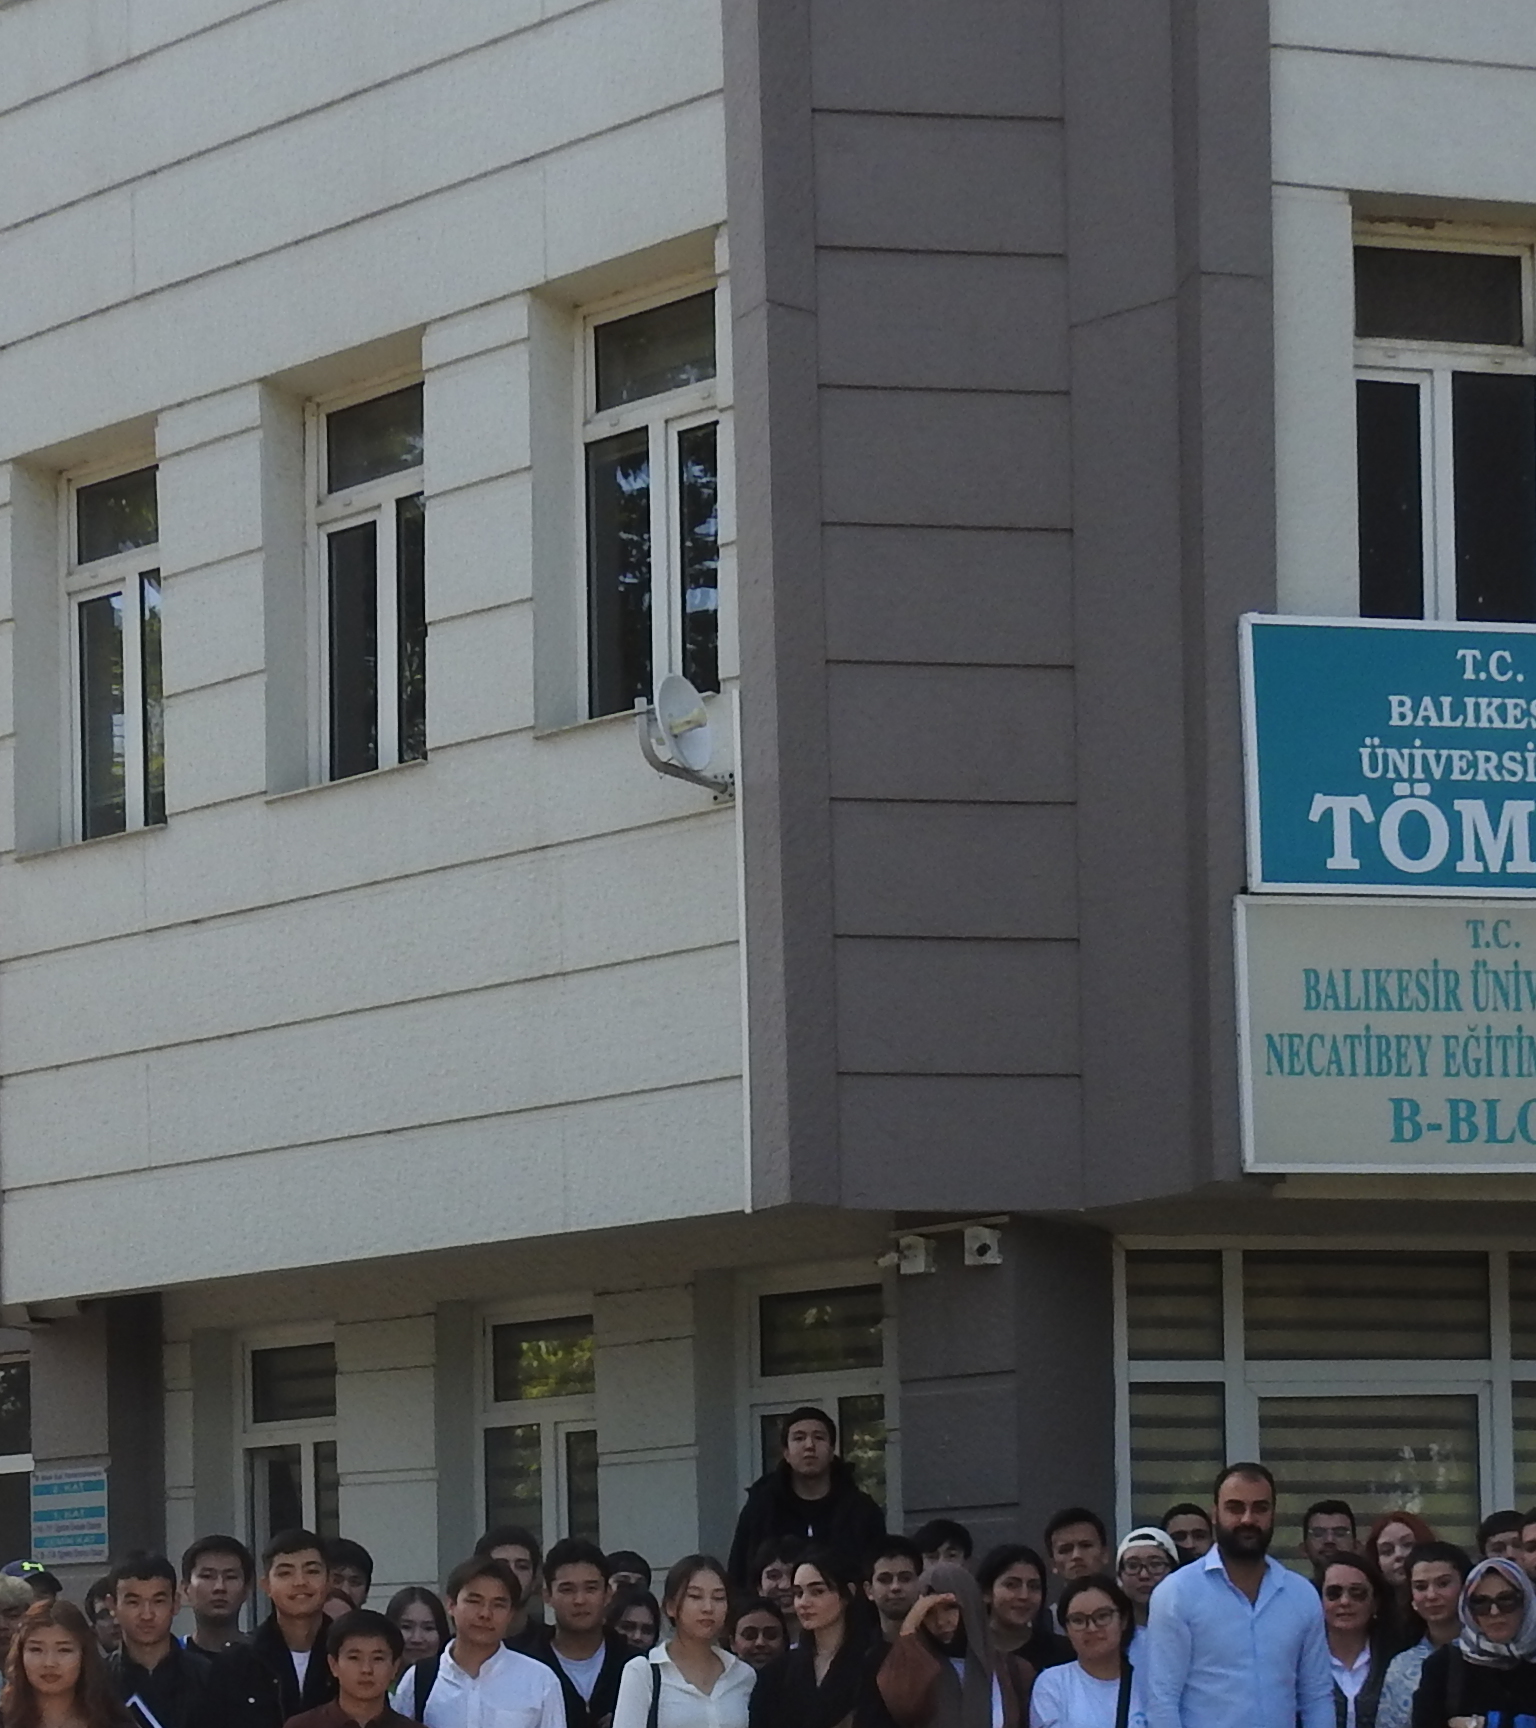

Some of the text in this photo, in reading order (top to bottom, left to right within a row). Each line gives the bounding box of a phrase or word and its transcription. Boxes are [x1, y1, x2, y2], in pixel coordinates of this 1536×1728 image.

[1456, 649, 1524, 682] T.C.
[1466, 919, 1521, 949] T.C.
[1303, 958, 1463, 1013] BALIKESİR
[1265, 1024, 1432, 1078] NECATİBEY
